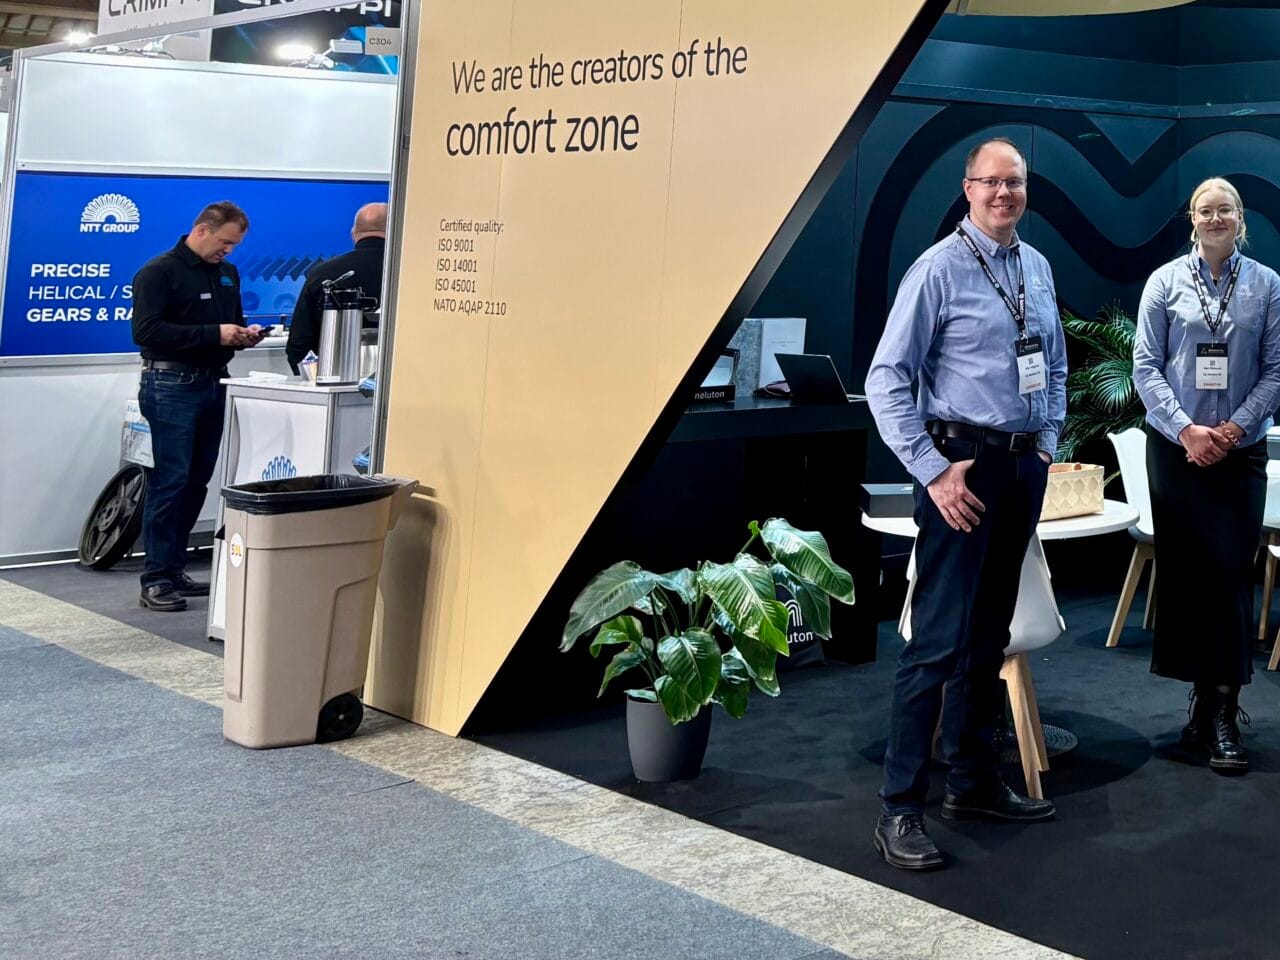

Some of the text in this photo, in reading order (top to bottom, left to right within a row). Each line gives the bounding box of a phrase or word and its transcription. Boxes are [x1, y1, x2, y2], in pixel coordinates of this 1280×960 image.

[369, 37, 392, 46] C304
[452, 36, 748, 94] We are the creators of the
[446, 106, 640, 156] comfort zone
[80, 223, 139, 233] NTT GROUP
[440, 218, 504, 235] Certified quality:
[438, 238, 474, 252] ISO 9001
[30, 263, 111, 278] PRECISE
[436, 258, 477, 272] ISO 14001
[28, 285, 106, 300] HELICAL
[121, 285, 133, 299] S
[435, 278, 476, 293] ISO 45001
[26, 307, 92, 322] GEARS
[96, 307, 109, 321] &
[433, 298, 507, 316] NATO AQAP 2110
[787, 631, 813, 644] uton
